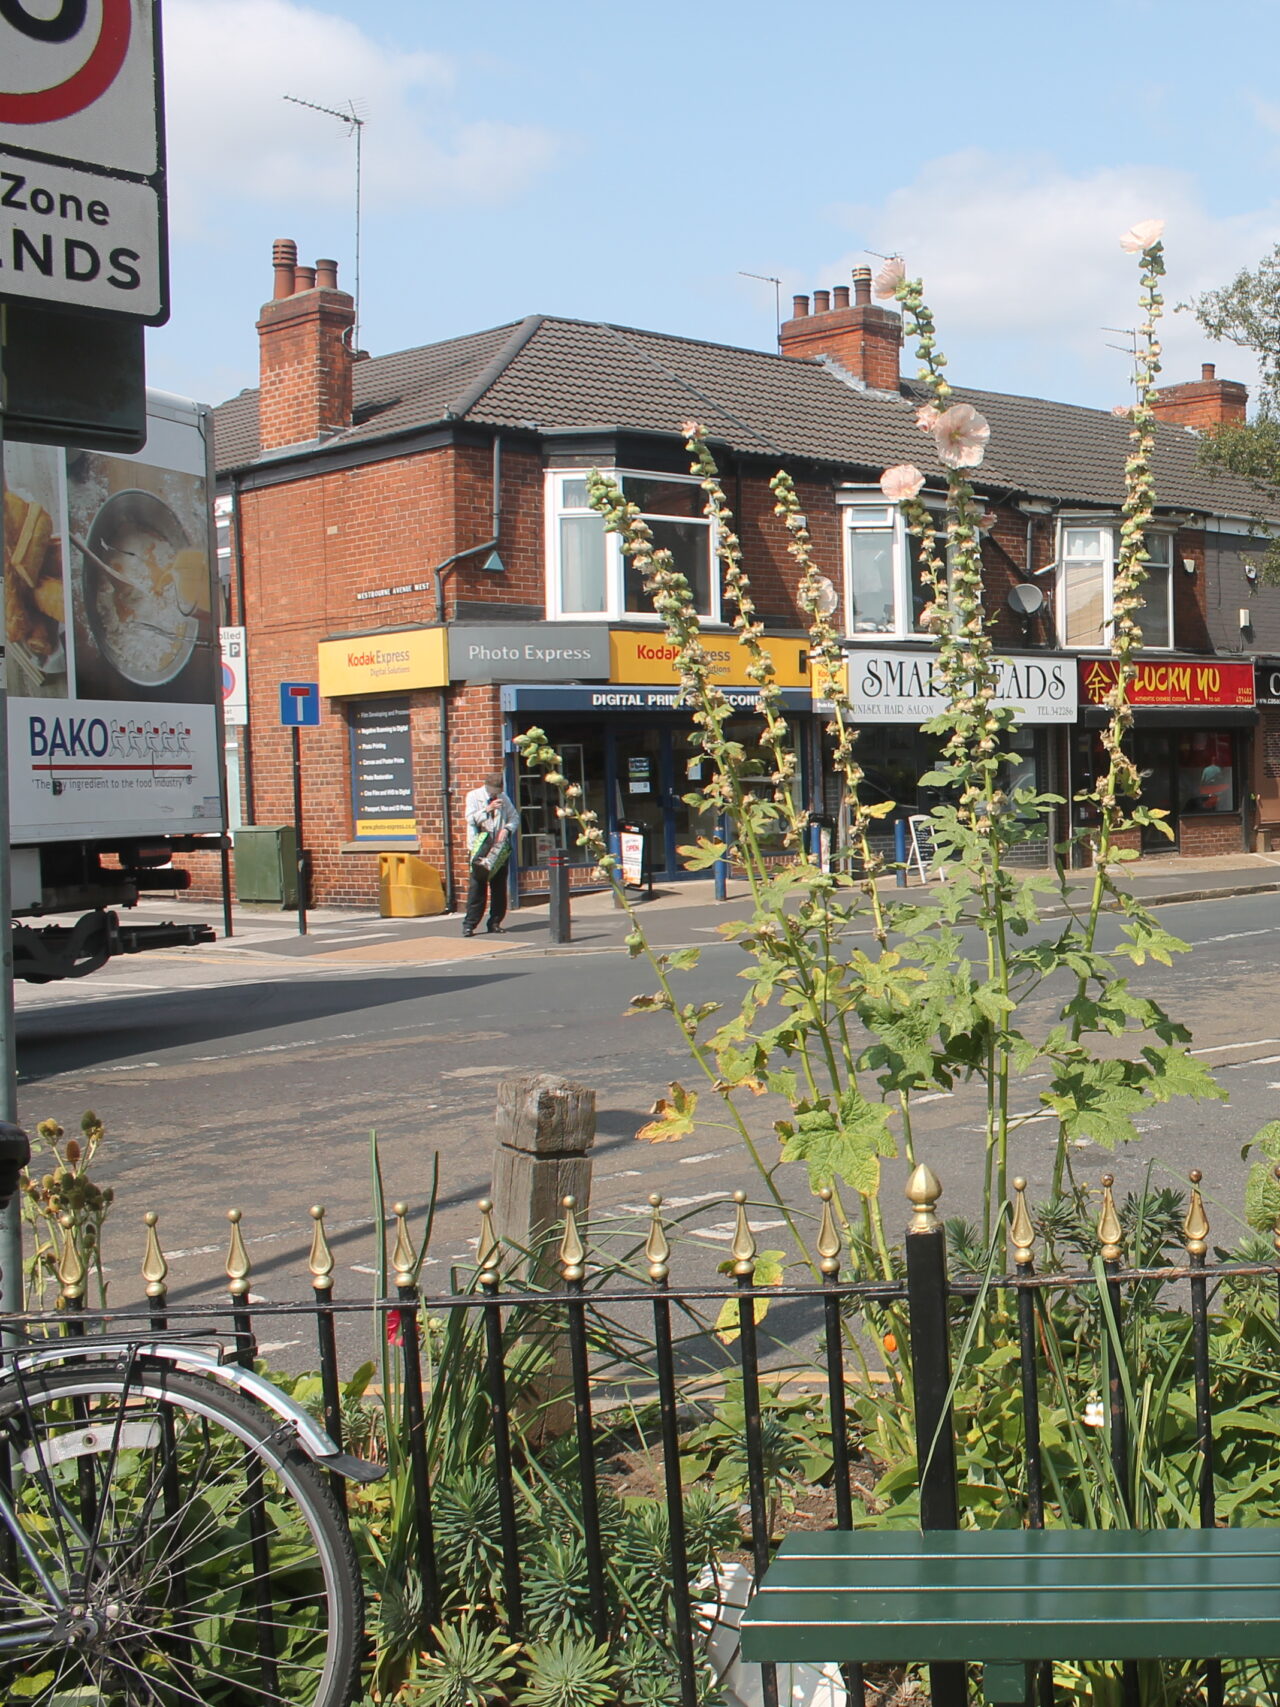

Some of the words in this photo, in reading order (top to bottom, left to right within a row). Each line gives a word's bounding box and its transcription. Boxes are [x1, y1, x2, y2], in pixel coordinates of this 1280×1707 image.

[1, 172, 110, 226] Zone
[0, 228, 141, 290] NDS
[469, 645, 520, 660] Photo
[525, 645, 591, 662] Express
[637, 645, 679, 660] Kodak
[862, 658, 951, 698] SMAR
[972, 663, 1066, 700] EADS
[1134, 664, 1191, 700] LUCKY
[1196, 667, 1220, 700] YU
[592, 694, 644, 706] DIGITAL
[854, 704, 882, 715] UNISEX
[884, 704, 904, 715] HAIR
[906, 704, 934, 715] SALON
[30, 716, 109, 758] BAKO
[70, 779, 108, 791] ingredient
[111, 780, 119, 789] to
[122, 779, 134, 789] the
[136, 779, 152, 788] food
